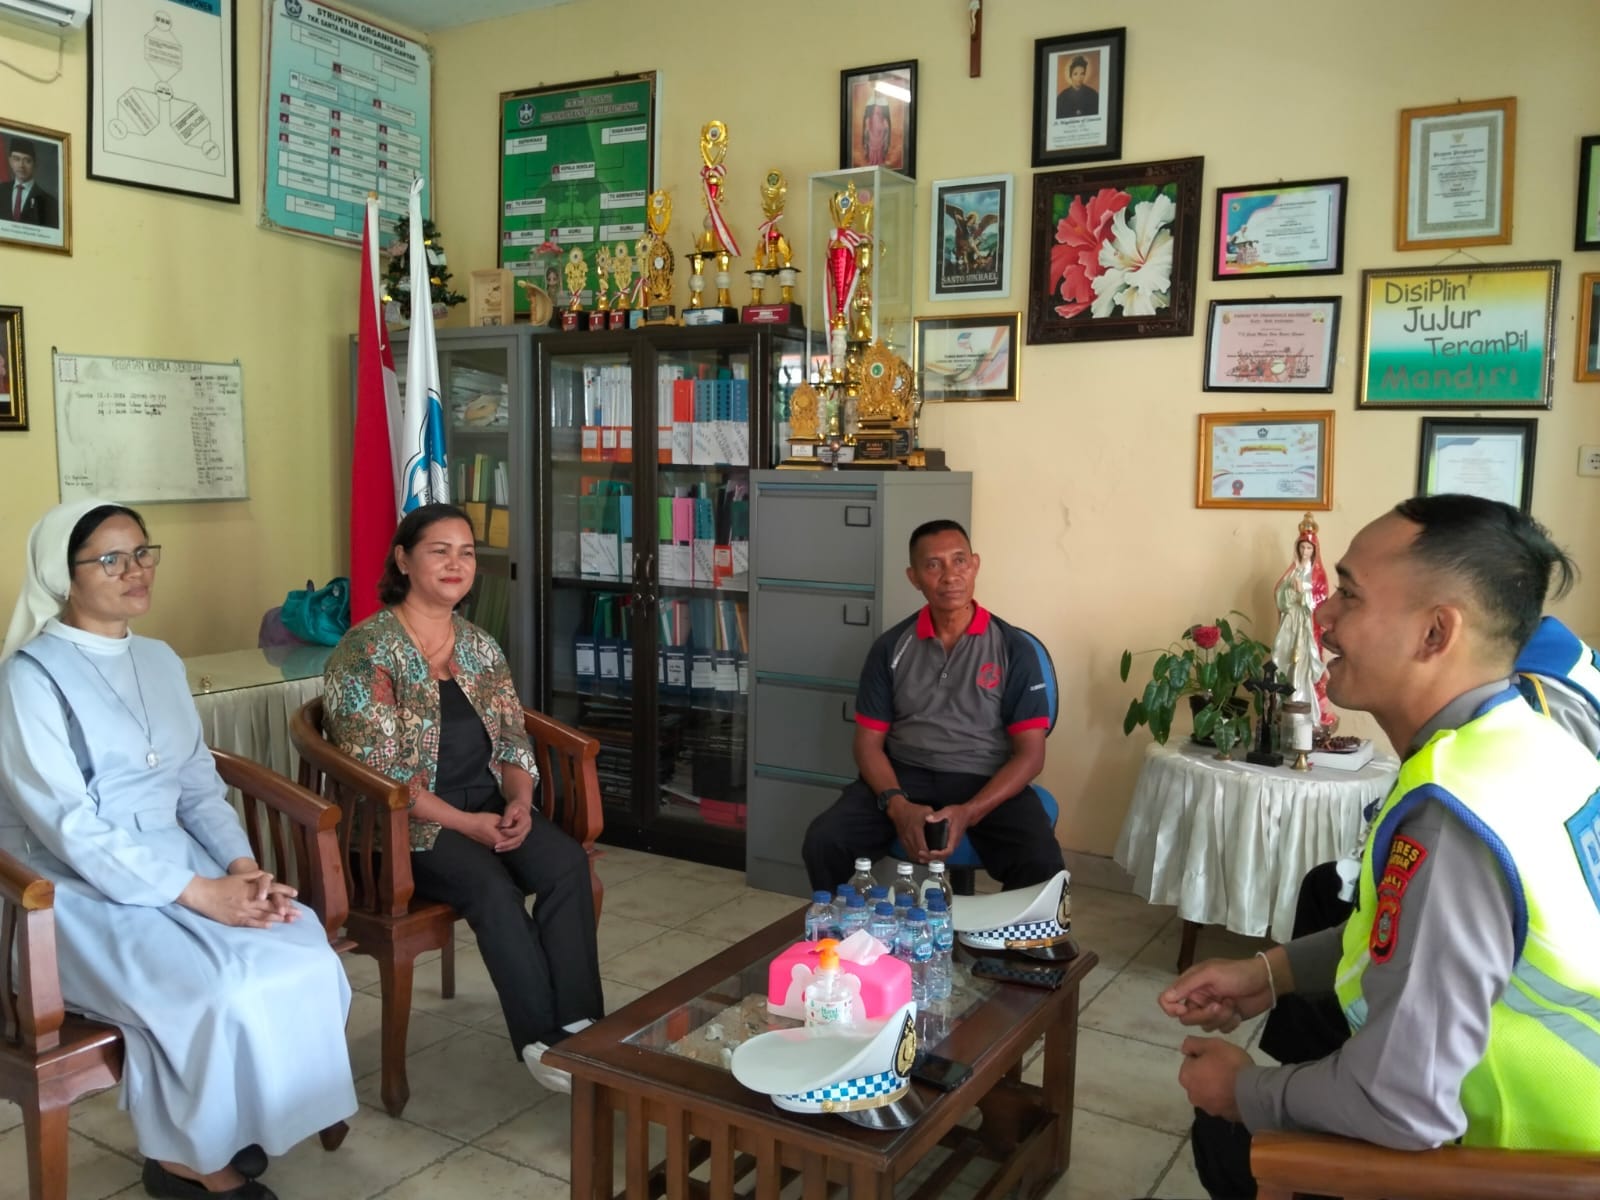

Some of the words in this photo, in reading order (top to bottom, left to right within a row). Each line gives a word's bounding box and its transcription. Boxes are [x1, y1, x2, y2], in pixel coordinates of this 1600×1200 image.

[317, 7, 360, 31] STRUKTUR
[360, 22, 406, 49] ORGANISASI
[320, 20, 339, 32] SANTA
[340, 27, 357, 39] MARIA
[358, 33, 373, 45] RATU
[941, 275, 965, 285] SANTO
